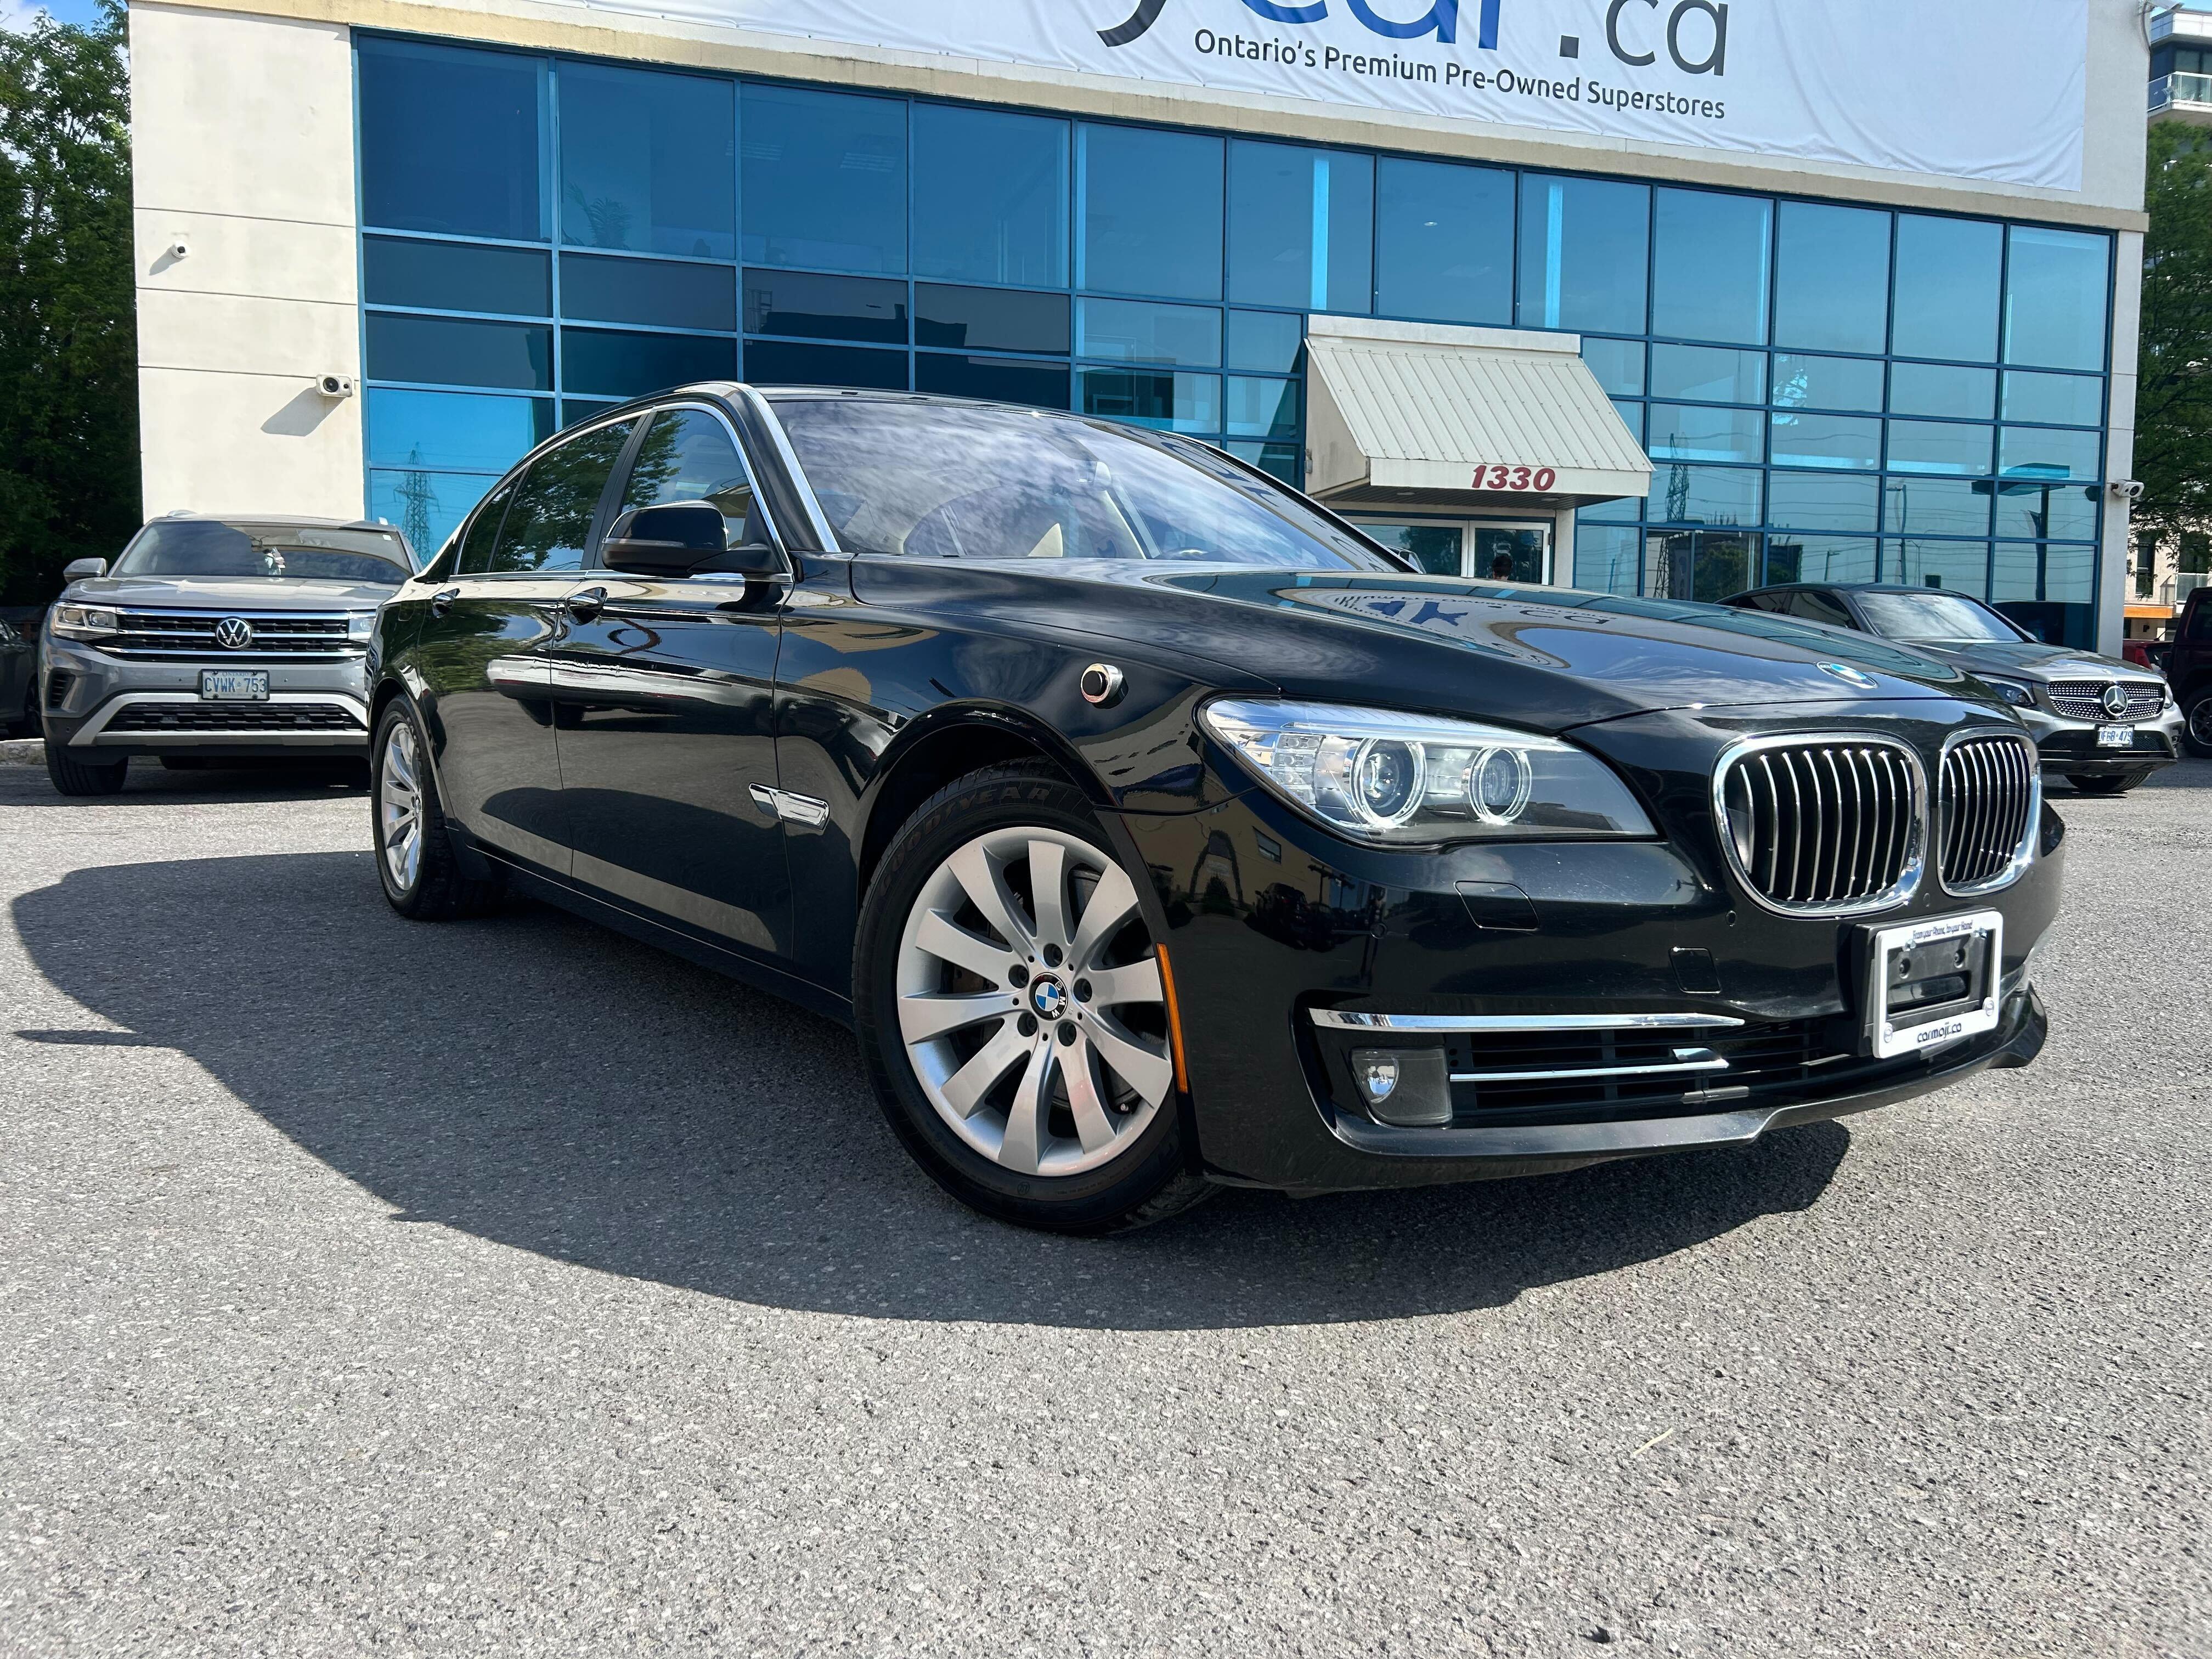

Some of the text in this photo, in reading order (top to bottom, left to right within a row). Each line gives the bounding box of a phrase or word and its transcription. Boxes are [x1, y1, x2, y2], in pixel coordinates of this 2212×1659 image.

[1194, 29, 1725, 119] Ontario’s Premium Pre-Owned Superstores
[1471, 465, 1556, 491] 1330
[205, 677, 267, 692] CVWK 753
